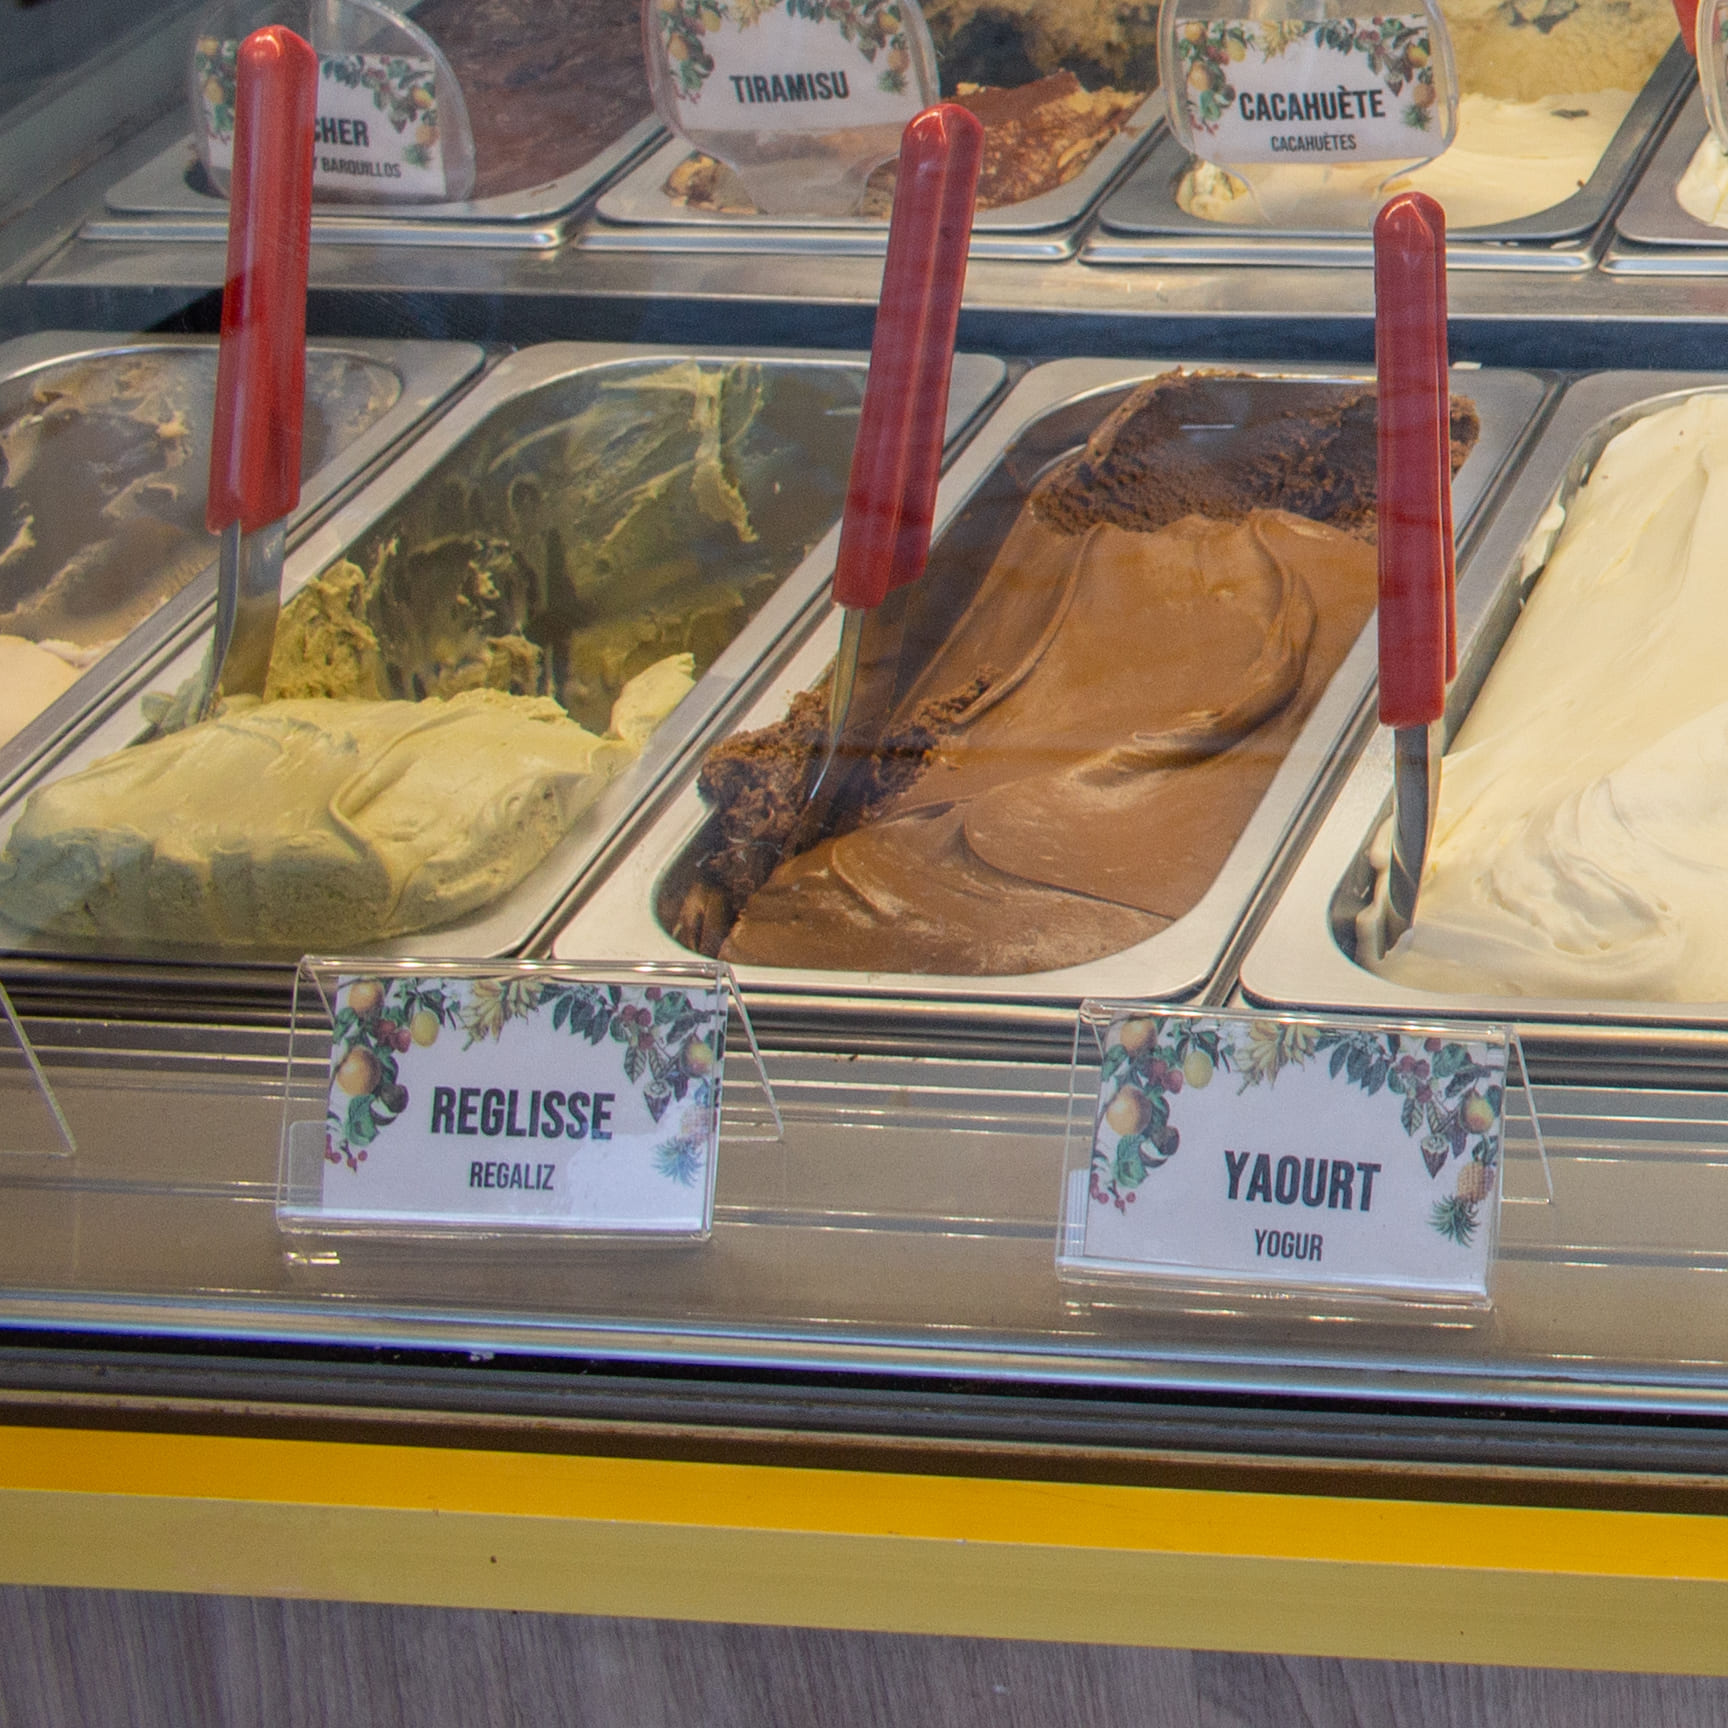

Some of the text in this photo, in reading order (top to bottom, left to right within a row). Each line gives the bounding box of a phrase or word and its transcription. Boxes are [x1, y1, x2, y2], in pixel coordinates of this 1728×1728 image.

[729, 70, 850, 106] TIRAMISU
[1238, 84, 1386, 121] CACAHUÈTE
[430, 1085, 616, 1141] REGLISSE
[469, 1161, 555, 1191] REGALIZ
[1224, 1149, 1382, 1212] YAOURT
[1254, 1228, 1323, 1262] YOGUR
